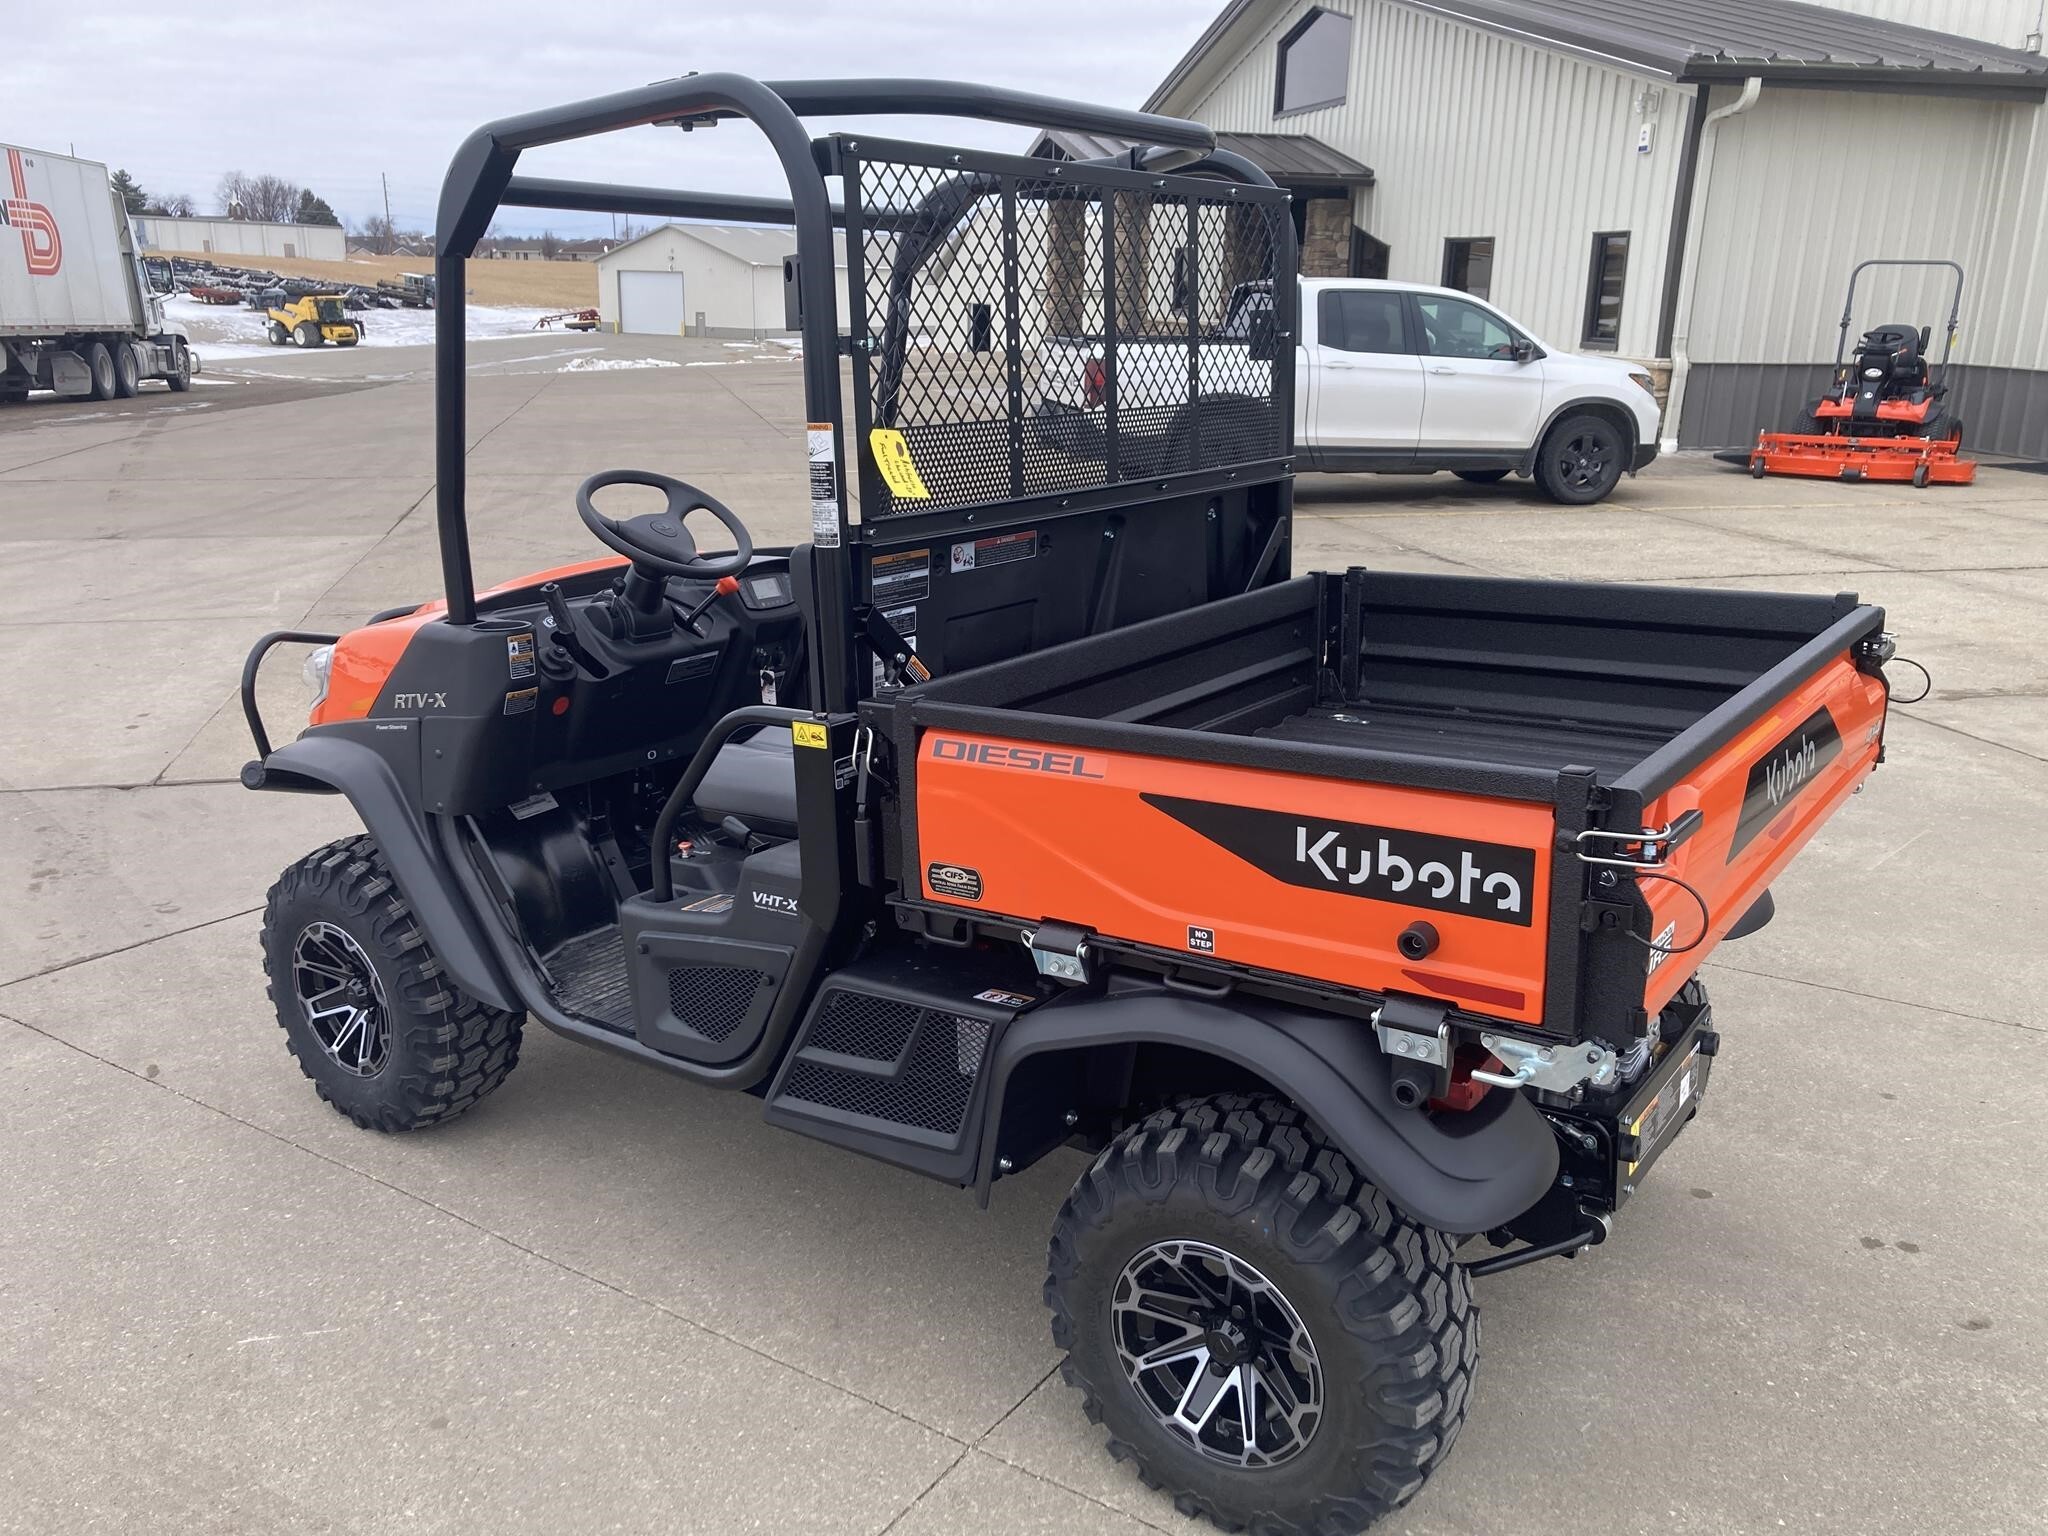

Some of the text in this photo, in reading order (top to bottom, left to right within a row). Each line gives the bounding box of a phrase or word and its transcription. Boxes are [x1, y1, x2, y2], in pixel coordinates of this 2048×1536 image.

[394, 692, 447, 709] RTV-X
[932, 739, 1105, 779] DIESEL
[1766, 733, 1816, 806] Kubota
[944, 870, 964, 880] CIFS
[1296, 826, 1521, 913] Kubota
[752, 891, 798, 911] VHT-X
[1190, 938, 1212, 948] STEP
[1194, 930, 1208, 939] NO
